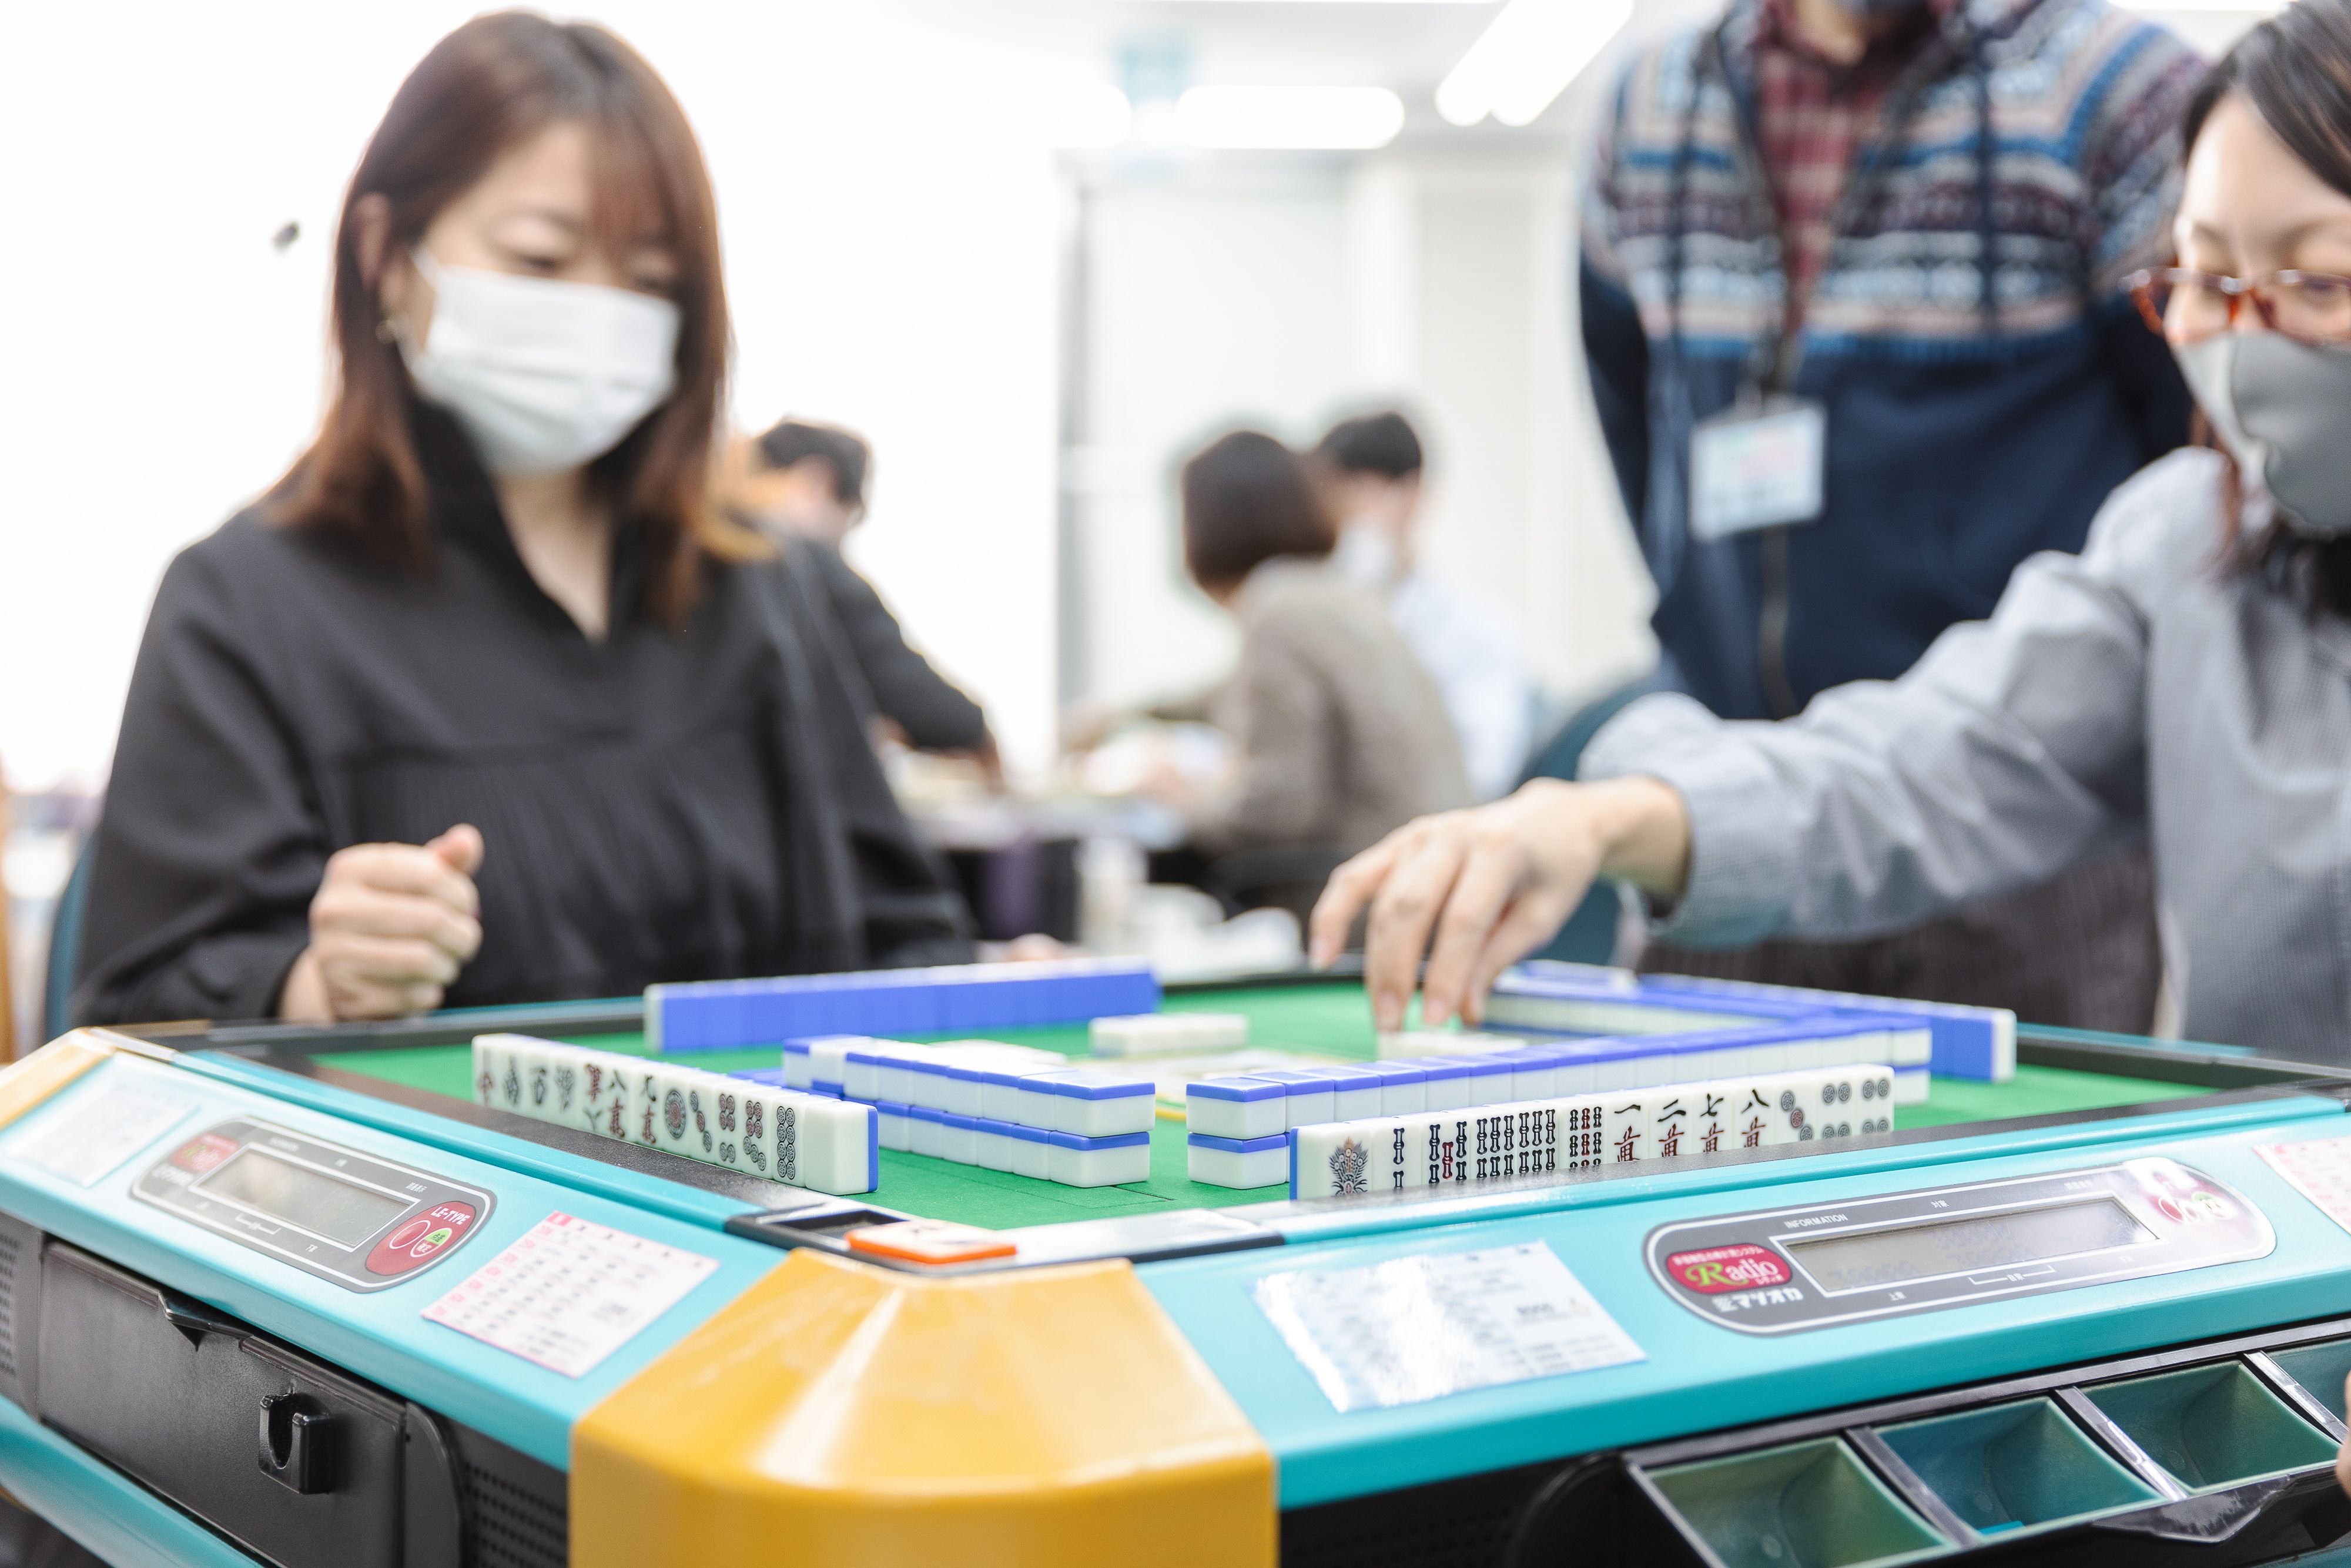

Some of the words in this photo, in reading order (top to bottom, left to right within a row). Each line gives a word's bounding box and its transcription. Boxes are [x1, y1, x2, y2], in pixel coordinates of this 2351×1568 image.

[430, 1206, 471, 1225] LE-TYPE
[1784, 1214, 1848, 1229] INFORMATION
[1684, 1258, 1780, 1286] Radio
